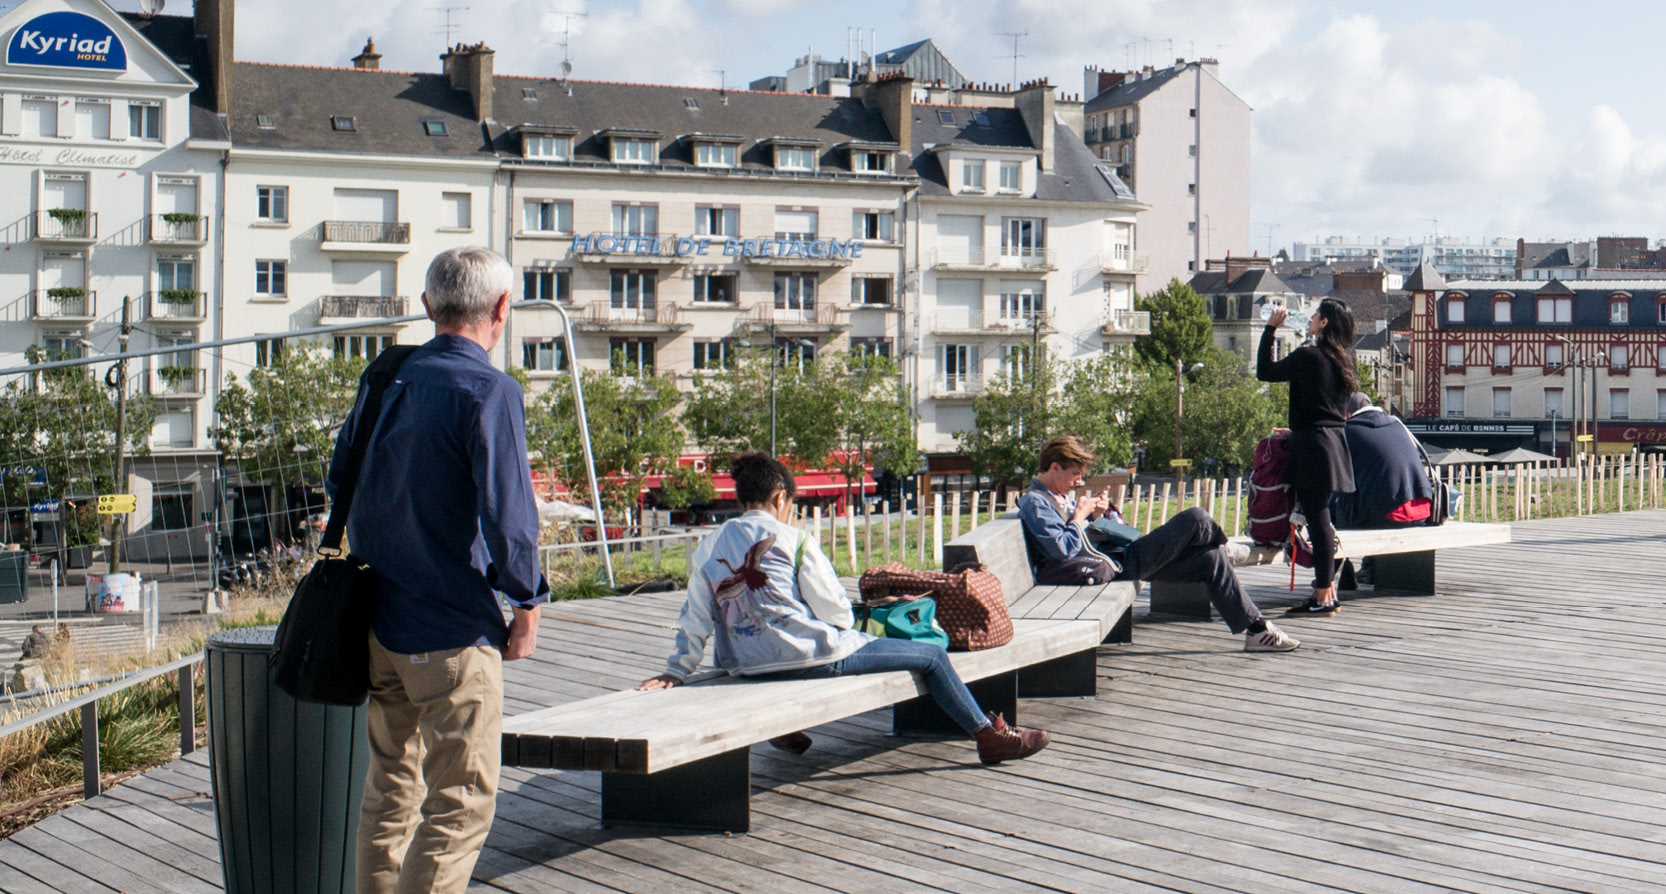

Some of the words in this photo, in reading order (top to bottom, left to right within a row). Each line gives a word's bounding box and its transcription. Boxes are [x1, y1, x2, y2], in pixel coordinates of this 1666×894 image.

[20, 30, 112, 54] Kyriad
[571, 233, 664, 255] HOTEL
[676, 237, 711, 256] DE
[723, 238, 864, 259] BRETAGNE
